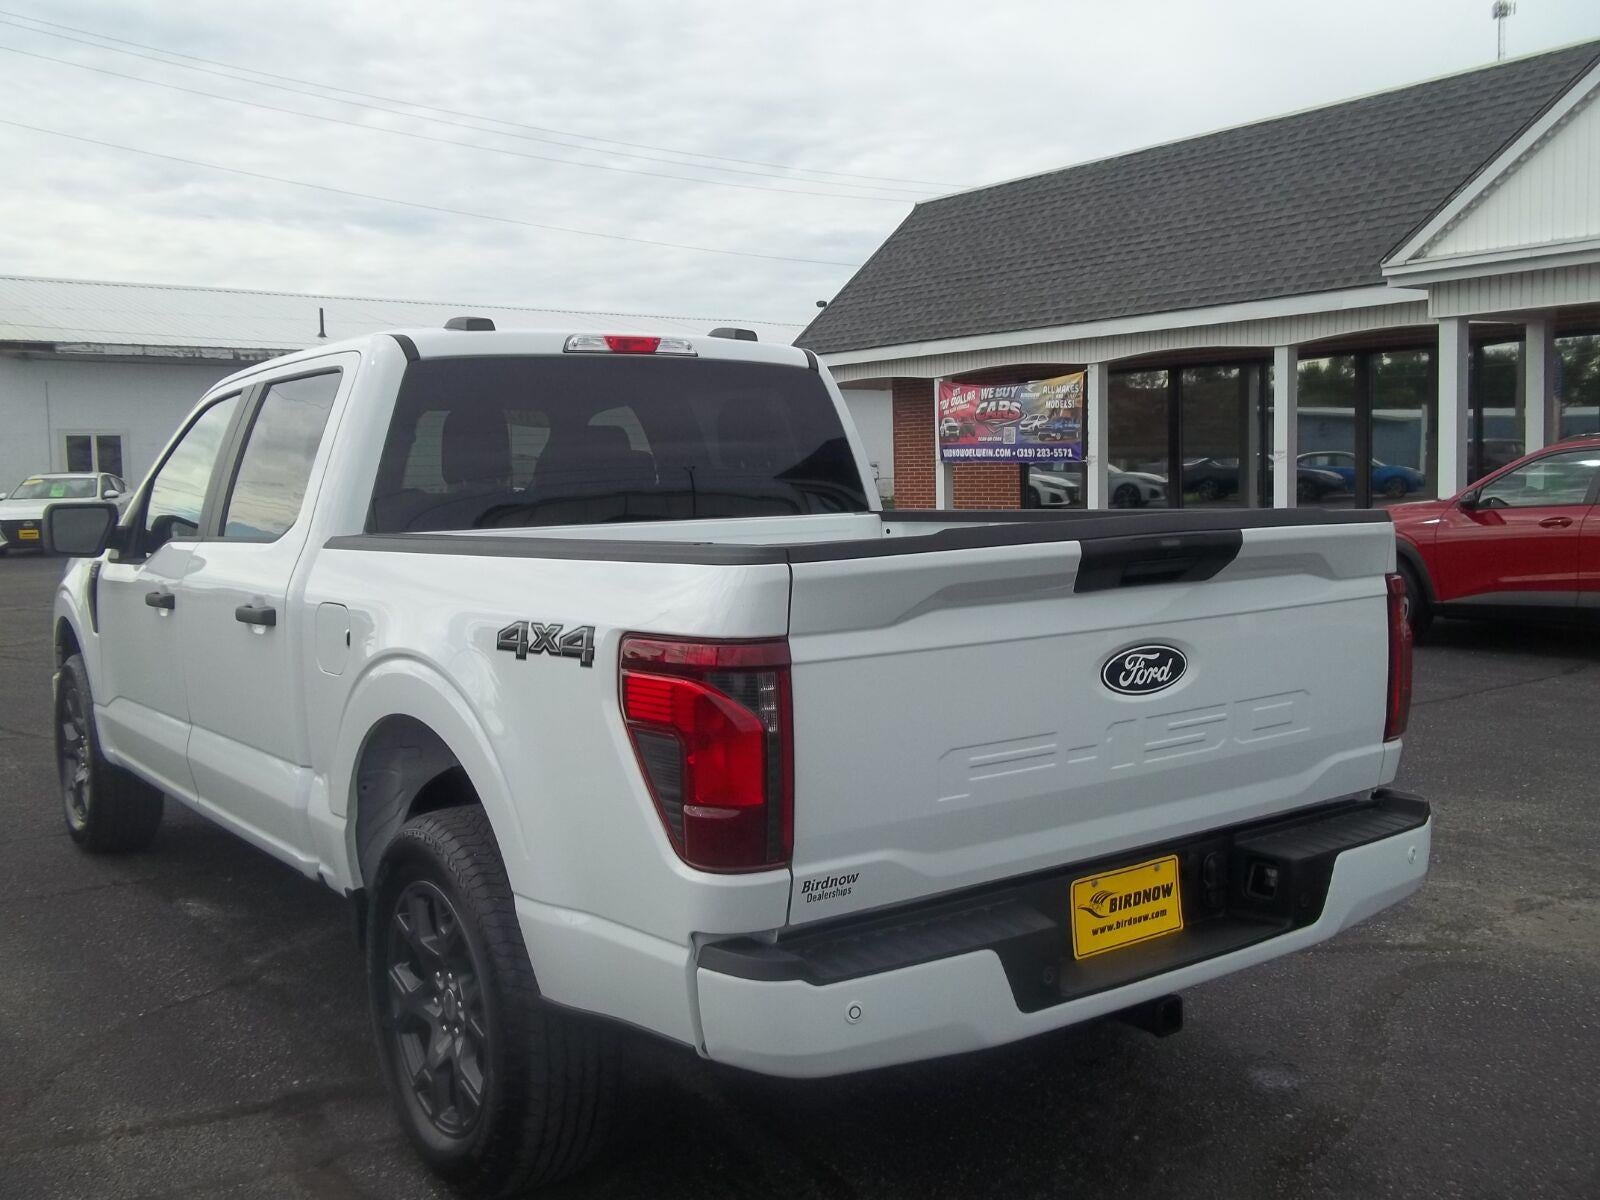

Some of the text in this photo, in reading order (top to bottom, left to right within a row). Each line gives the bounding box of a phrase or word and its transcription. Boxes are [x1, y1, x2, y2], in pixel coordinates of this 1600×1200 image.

[980, 386, 1019, 400] WE BUY
[1042, 384, 1080, 394] ALL MAKES
[950, 390, 976, 407] DOLLAR
[1045, 400, 1075, 409] MODELS!
[975, 400, 1022, 421] CARS
[1016, 448, 1035, 458] (319)
[1036, 448, 1073, 458] 283-5571
[1119, 652, 1174, 687] Ford
[801, 872, 860, 894] Birdnow
[806, 886, 852, 904] Dealerships
[1108, 881, 1174, 913] BIRDNOW
[1091, 908, 1168, 937] www.birdnow.com
